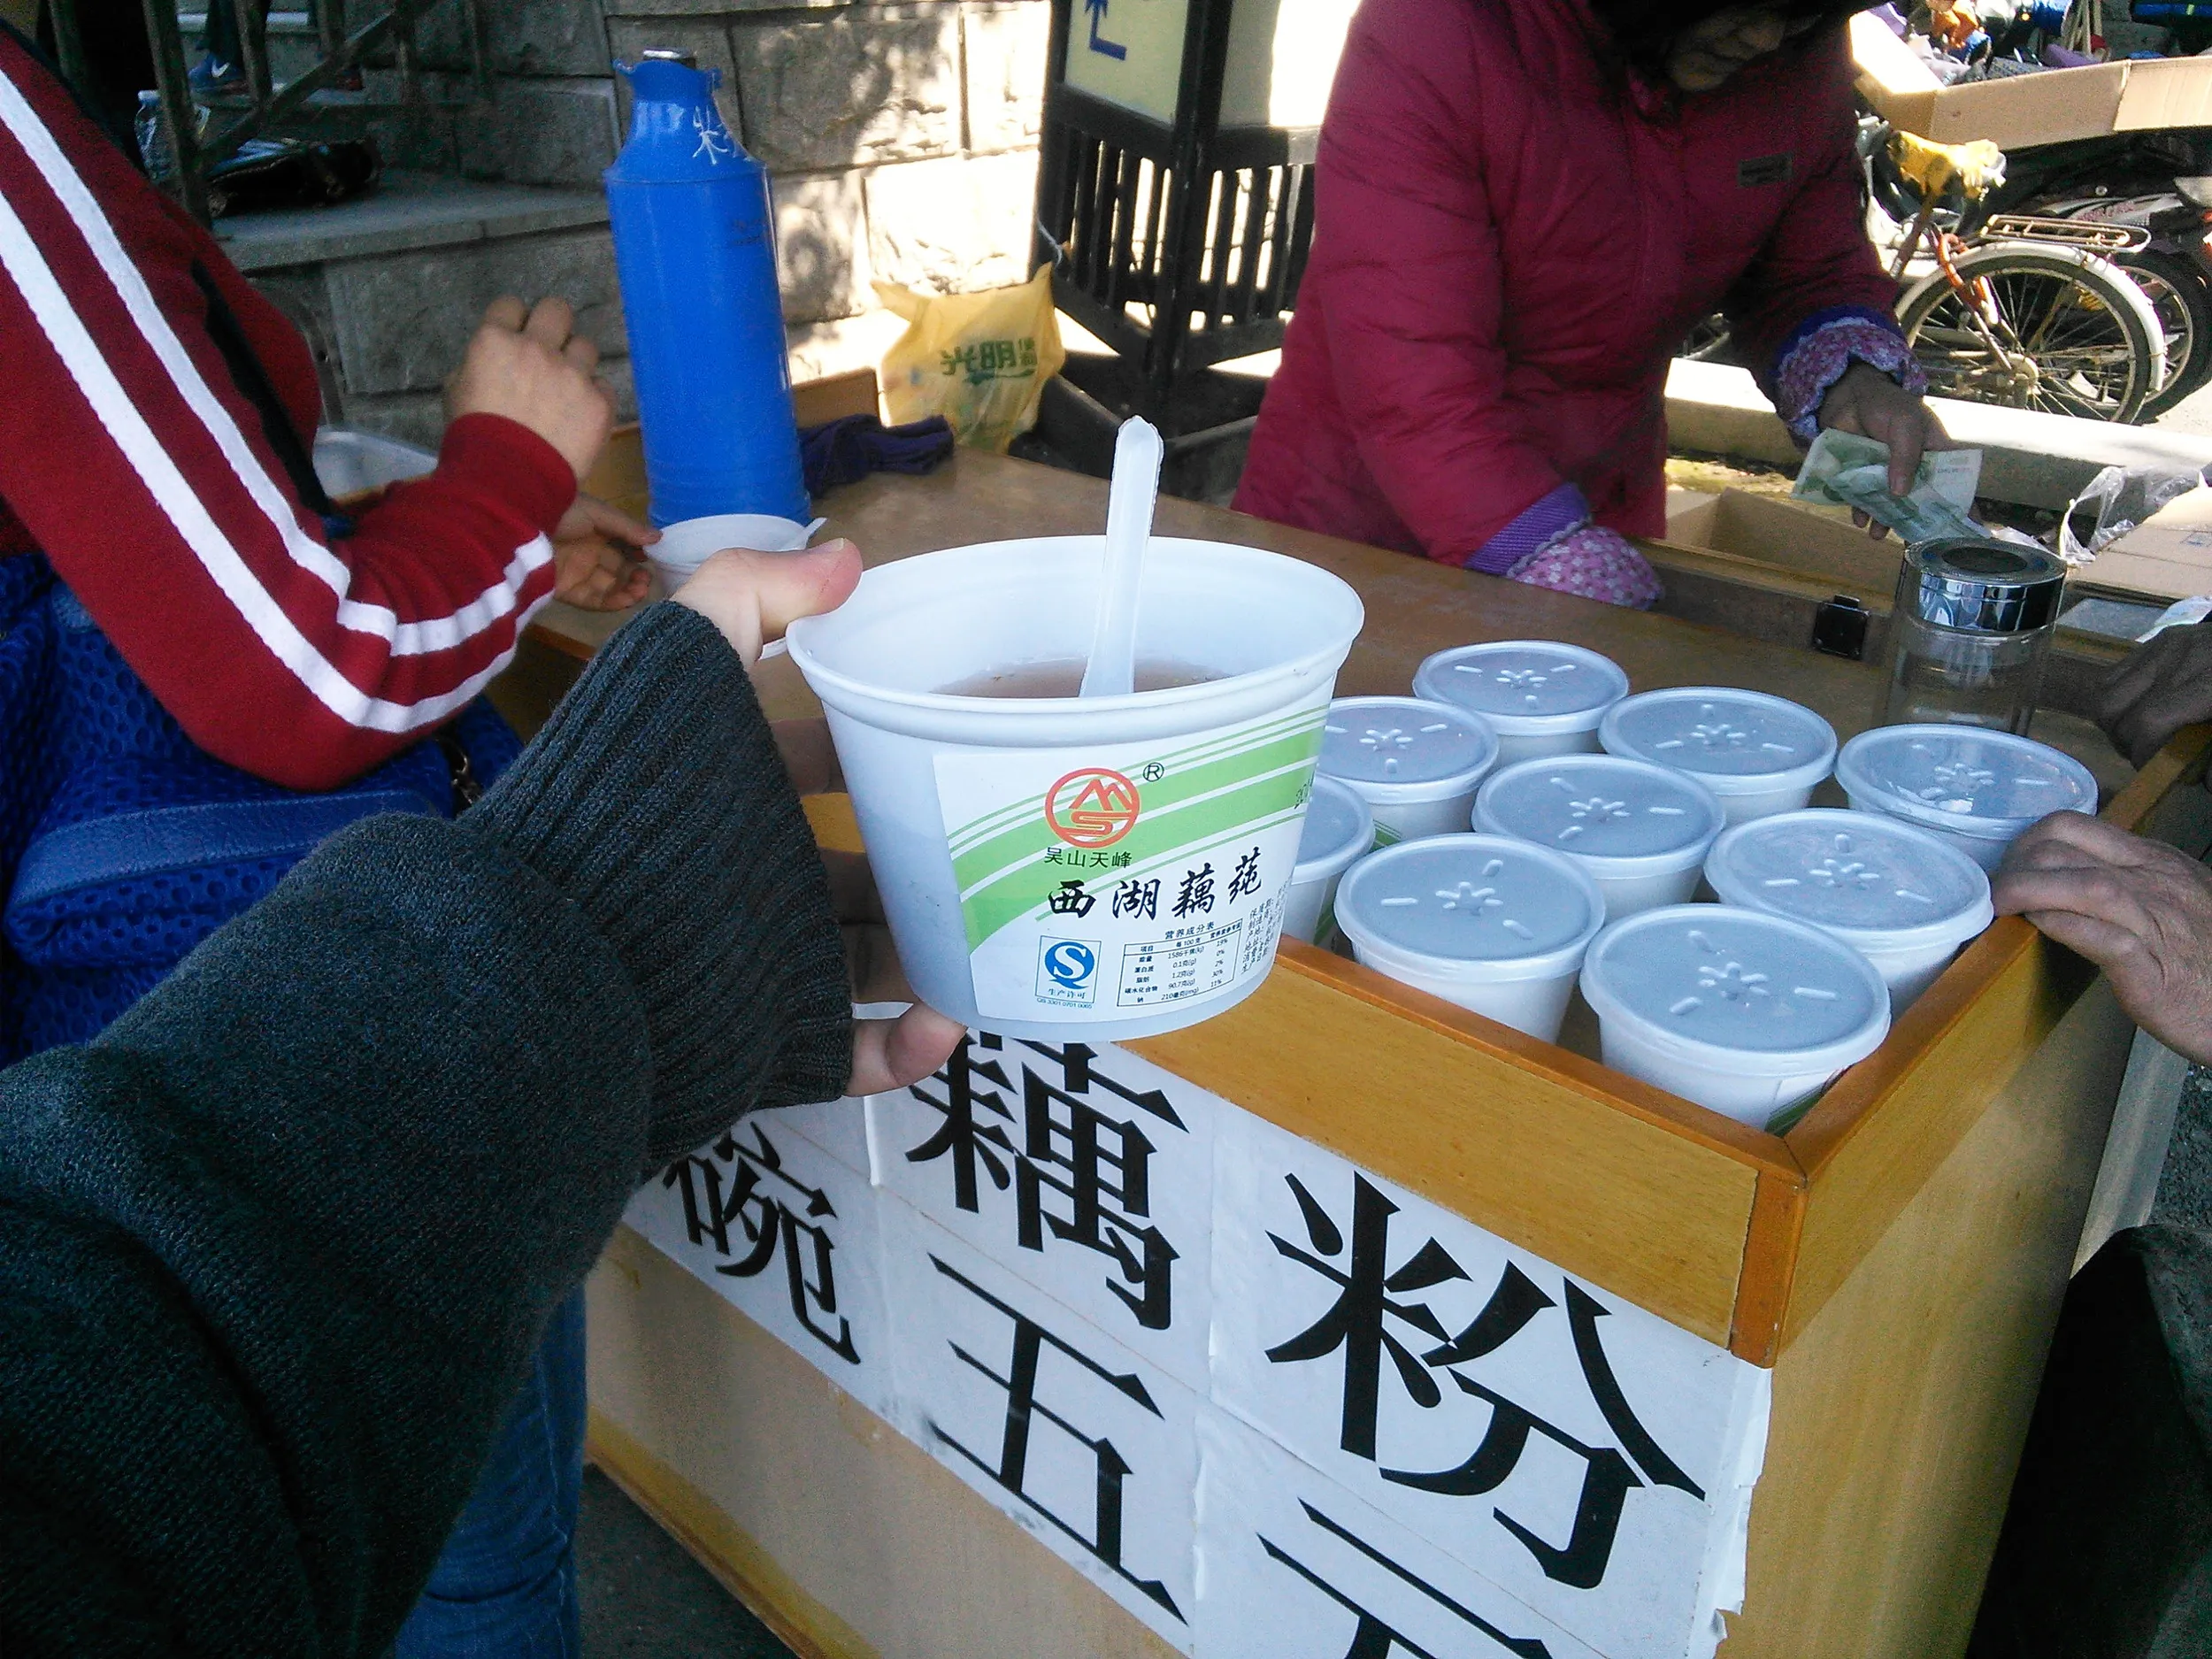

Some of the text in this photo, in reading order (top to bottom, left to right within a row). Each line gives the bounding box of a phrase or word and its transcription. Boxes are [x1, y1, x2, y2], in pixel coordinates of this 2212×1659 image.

[1043, 847, 1133, 869] 吴山天峰
[1165, 921, 1215, 939] 营养成分表
